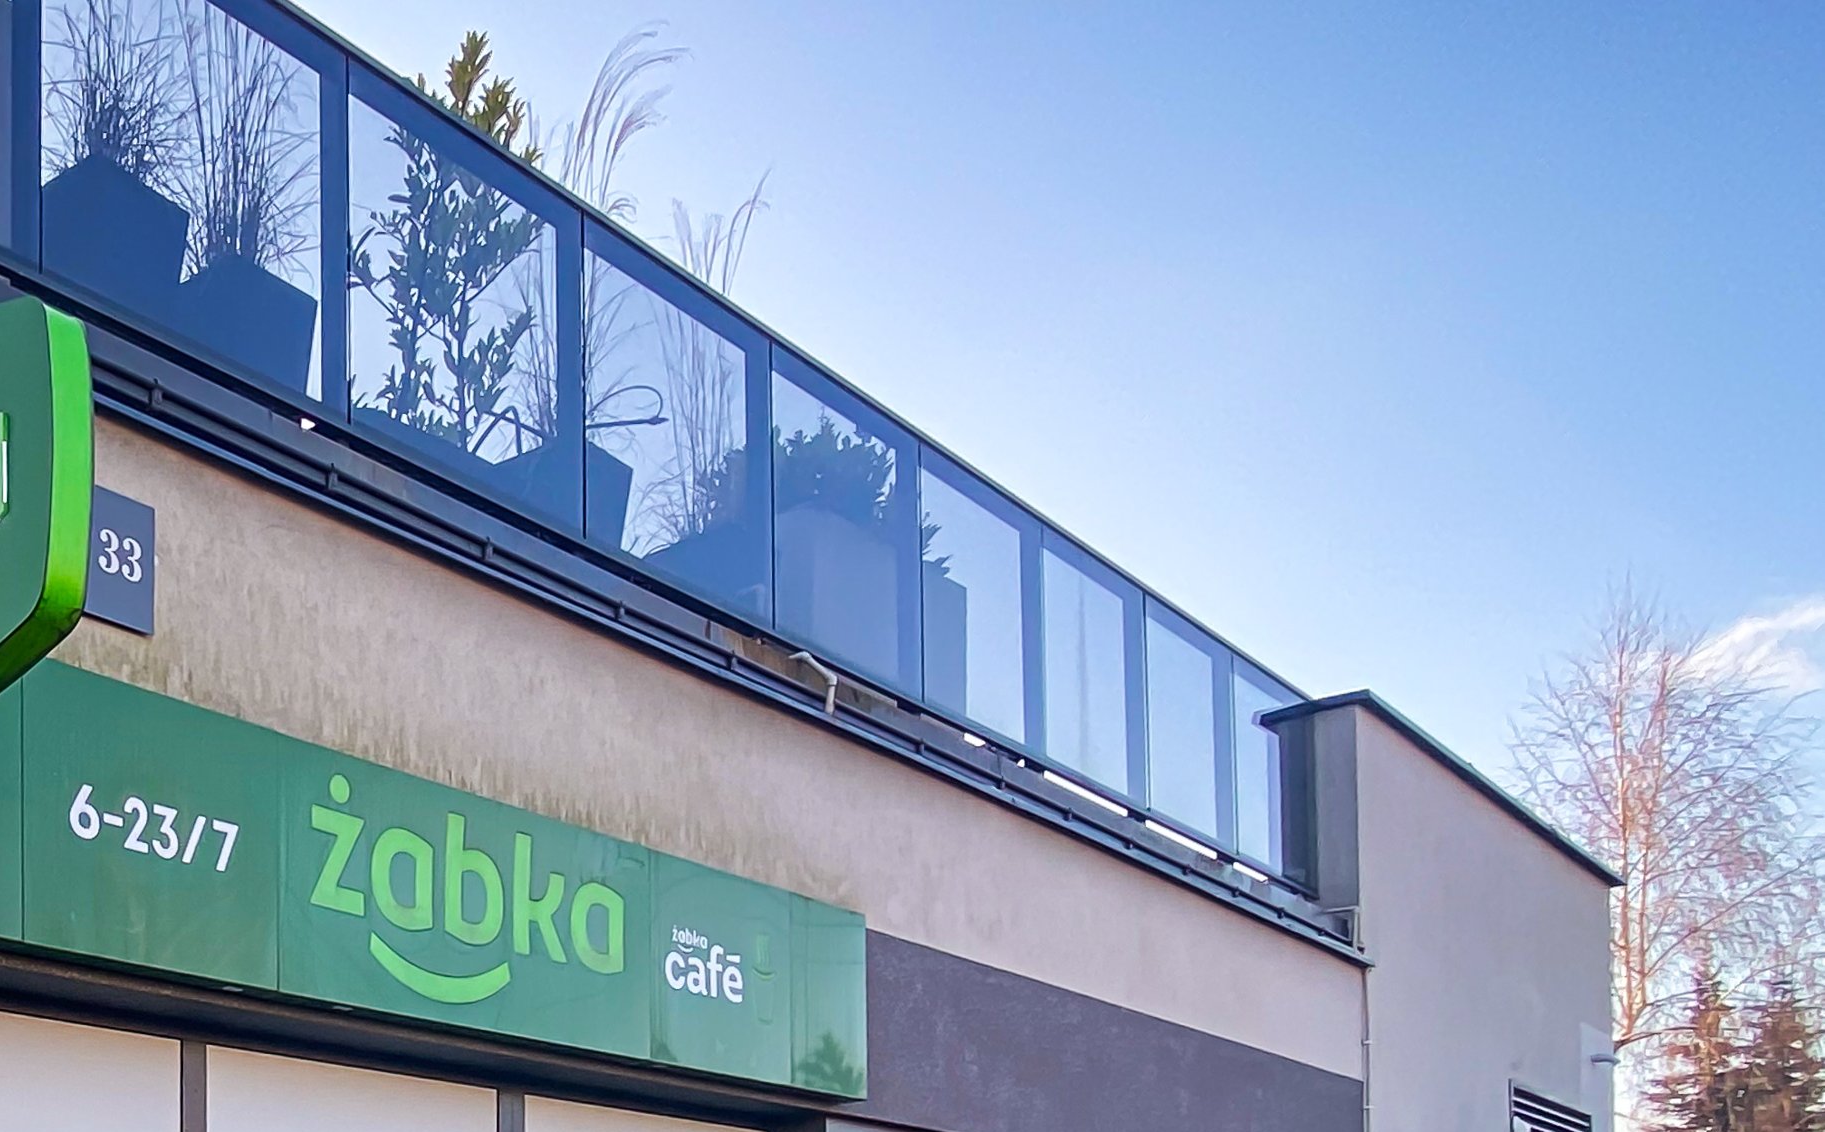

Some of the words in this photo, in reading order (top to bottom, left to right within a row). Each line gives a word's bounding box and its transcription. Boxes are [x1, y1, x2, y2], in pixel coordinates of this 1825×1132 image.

[98, 527, 143, 583] 33
[69, 784, 240, 872] 6-23/7
[310, 774, 626, 974] żabka
[671, 925, 708, 950] żabka
[664, 944, 744, 1004] café
